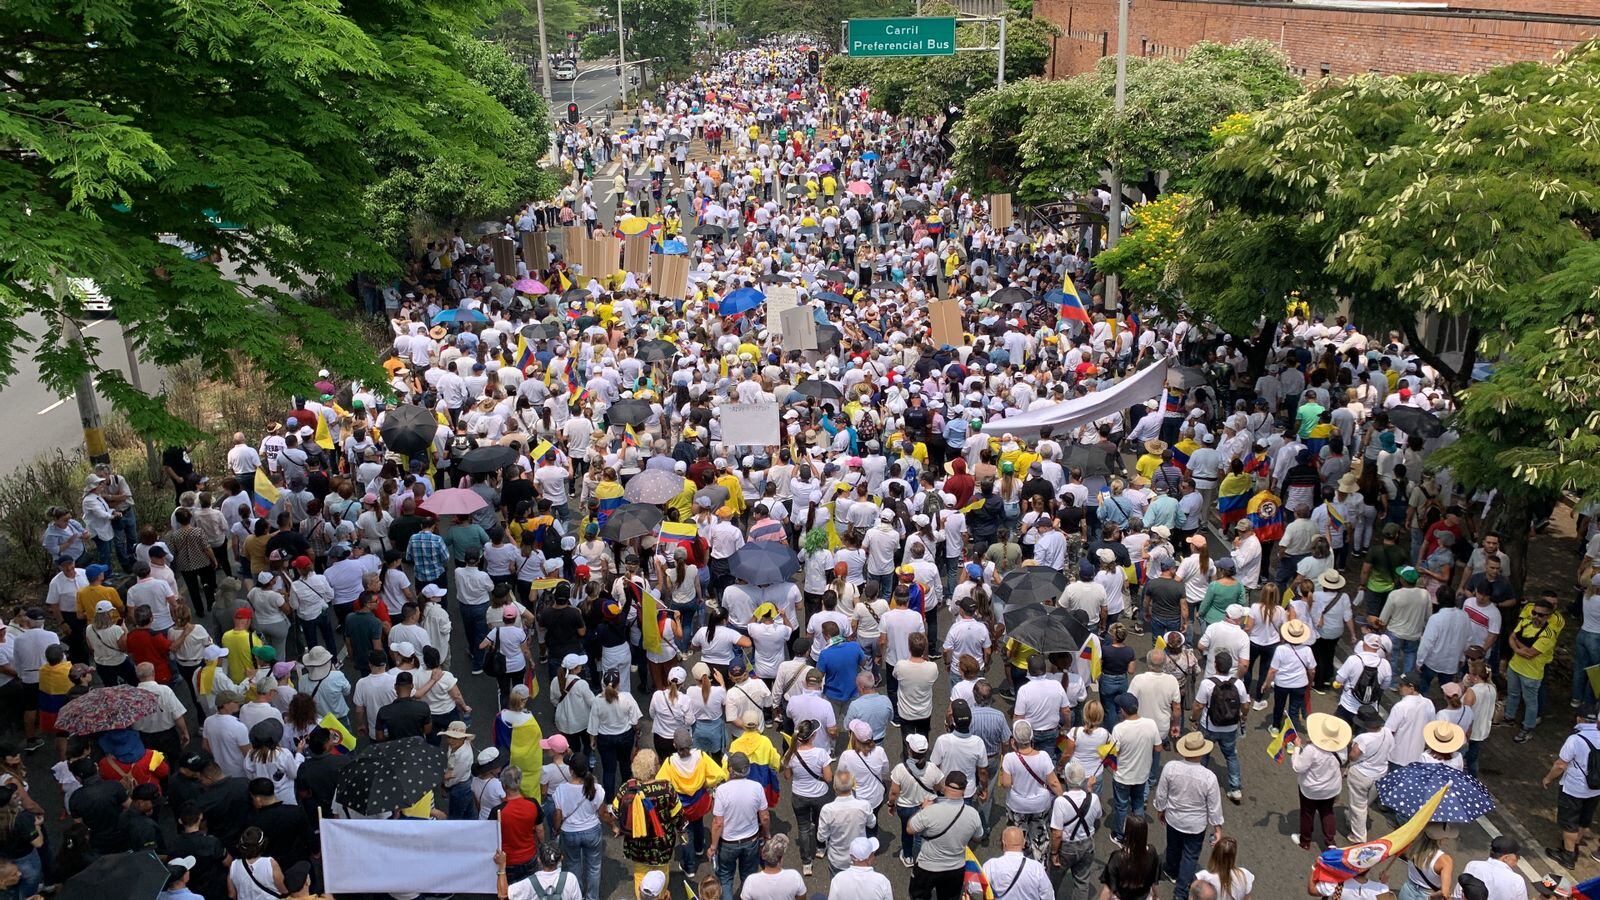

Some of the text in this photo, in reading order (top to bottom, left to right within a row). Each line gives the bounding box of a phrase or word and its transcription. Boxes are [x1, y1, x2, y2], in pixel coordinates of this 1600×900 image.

[885, 25, 918, 35] Carril
[854, 39, 950, 51] Preferencial Bus
